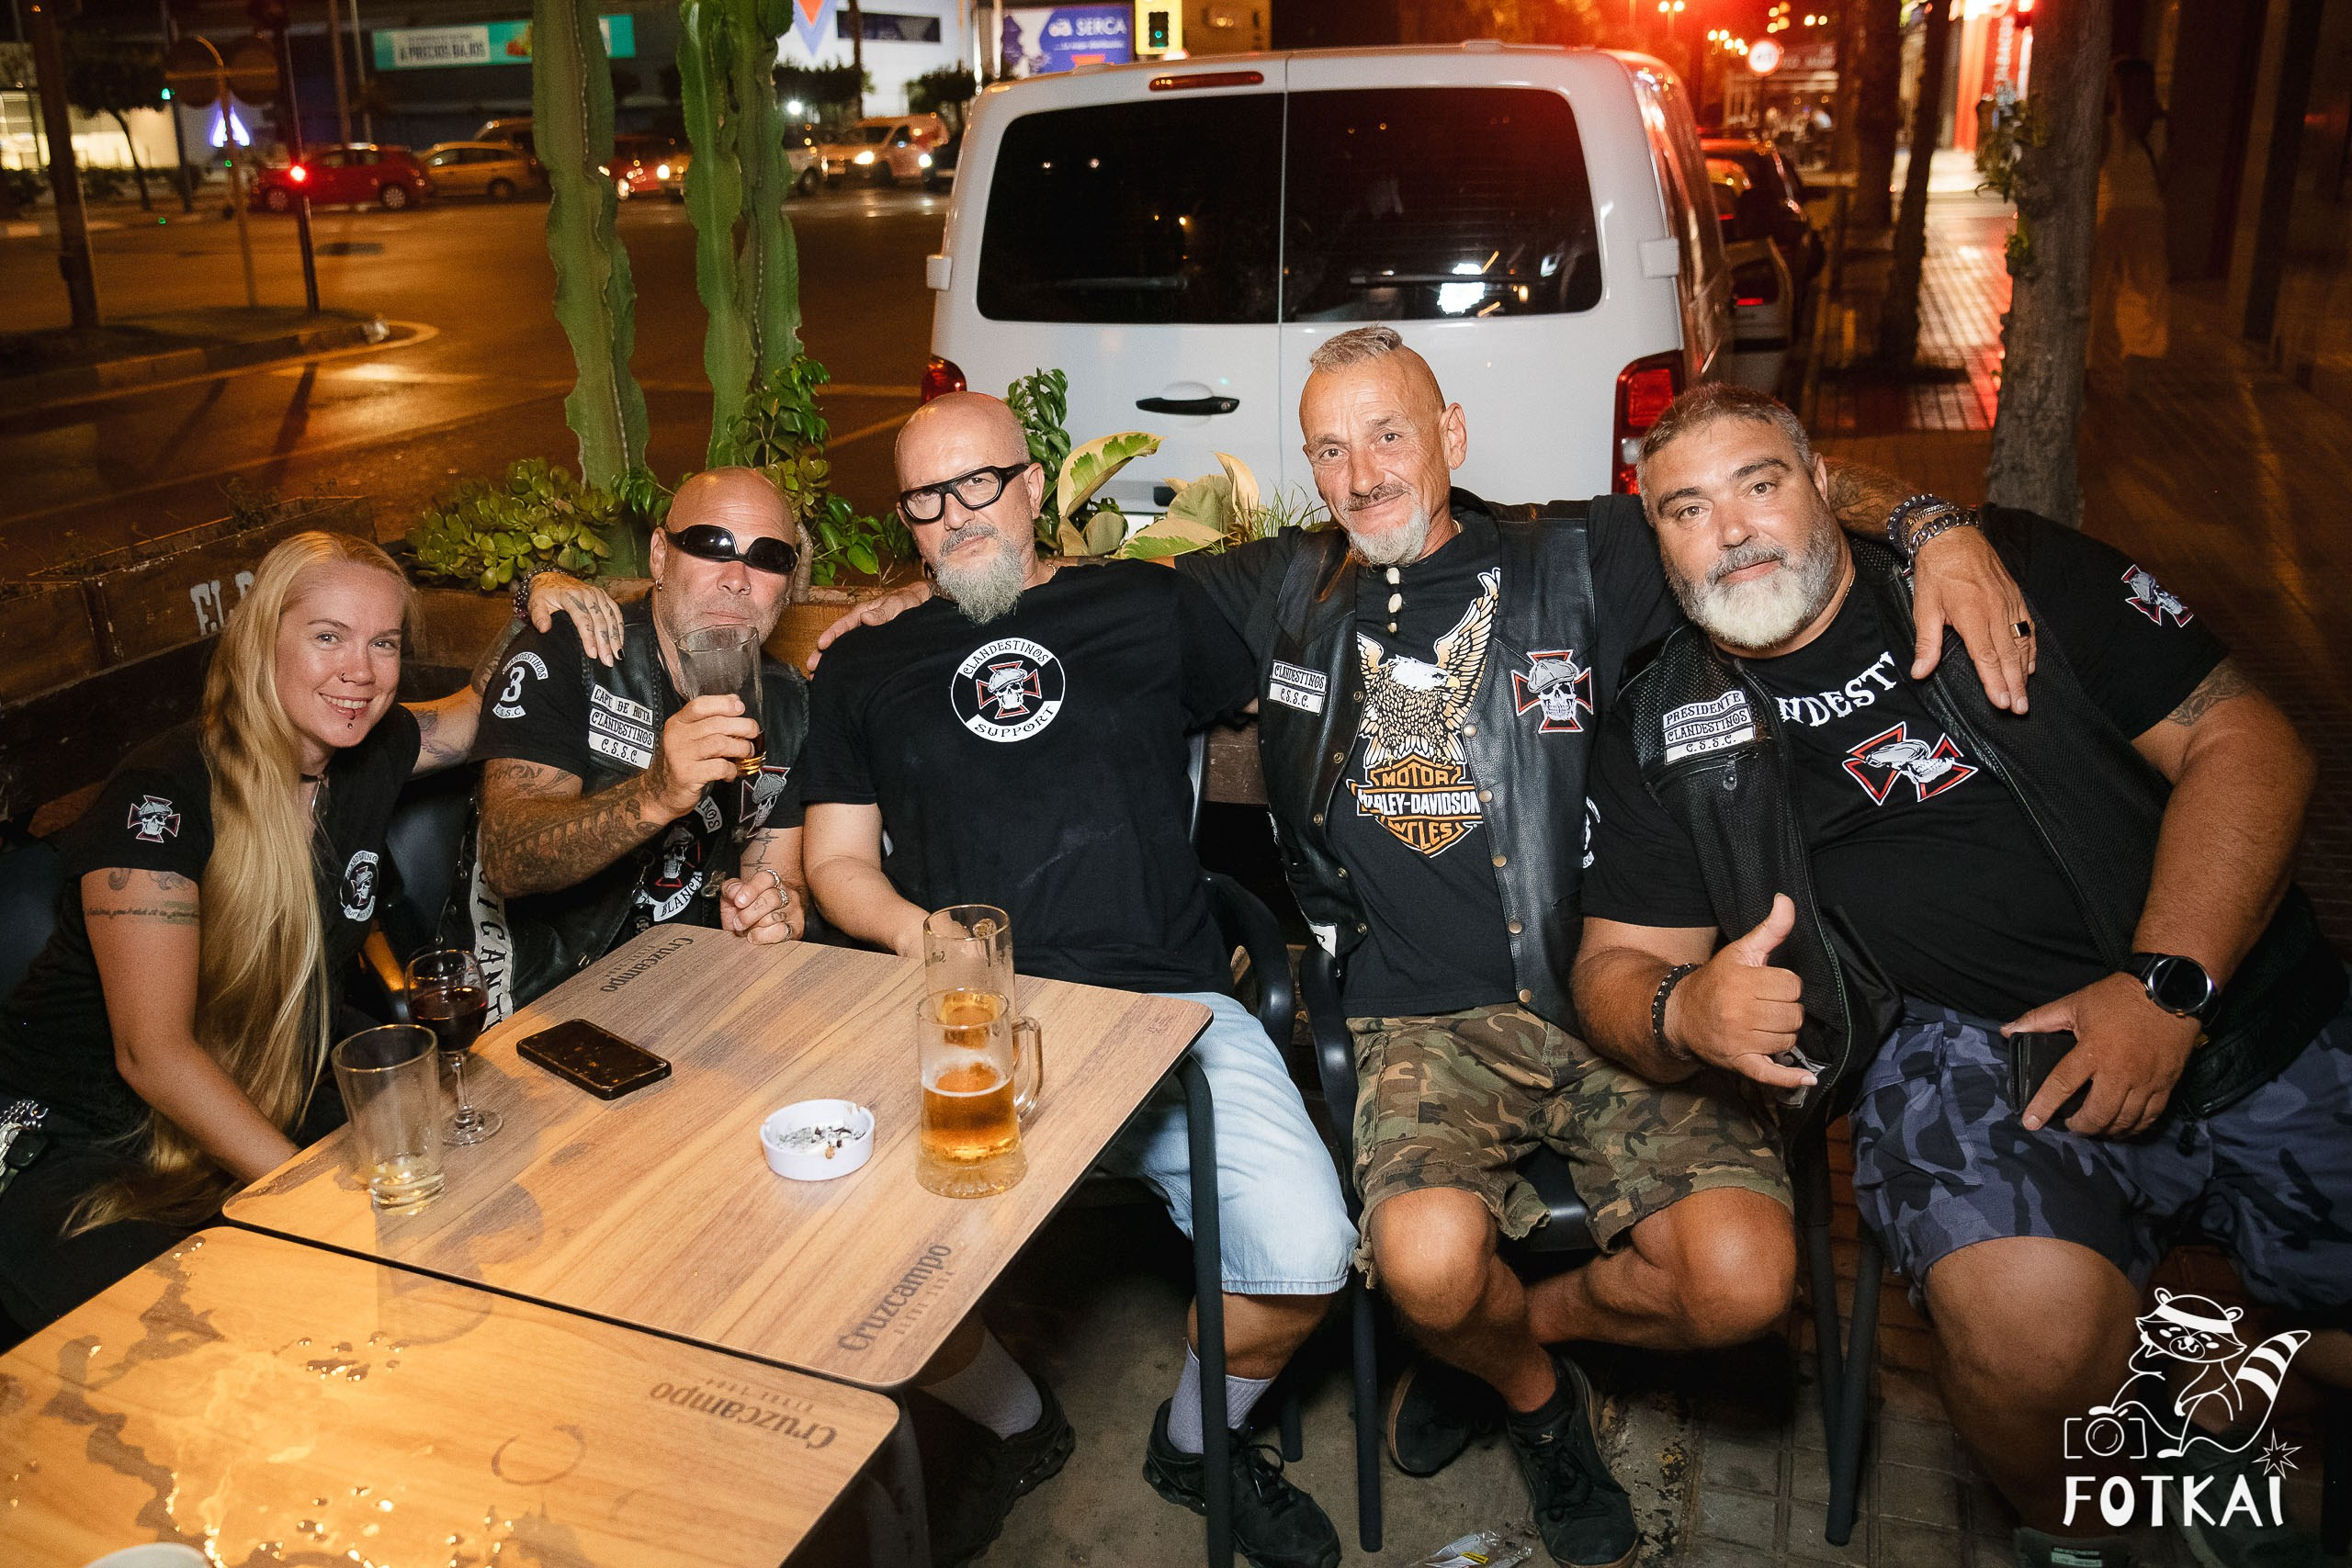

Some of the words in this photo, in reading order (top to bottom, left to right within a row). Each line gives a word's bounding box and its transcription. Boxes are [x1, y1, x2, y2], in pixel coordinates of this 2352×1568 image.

[1075, 16, 1127, 37] SERCA
[962, 640, 1049, 675] CLANDESTINOS
[501, 666, 526, 703] 3
[1274, 664, 1325, 689] CLANDESTINOS
[617, 701, 630, 715] DE
[632, 705, 651, 724] RUTA
[974, 705, 1055, 738] SUPPORT
[1666, 692, 1742, 726] PRESIDENTE
[1667, 710, 1748, 742] CLANDESTINOS
[592, 711, 654, 746] CLANDESTINOS
[1382, 761, 1449, 787] MOTOR
[660, 873, 703, 917] BLANCA
[600, 937, 694, 992] Cruzcampo
[838, 1244, 952, 1350] Cruzcampo
[650, 1382, 837, 1449] Cruzcampo
